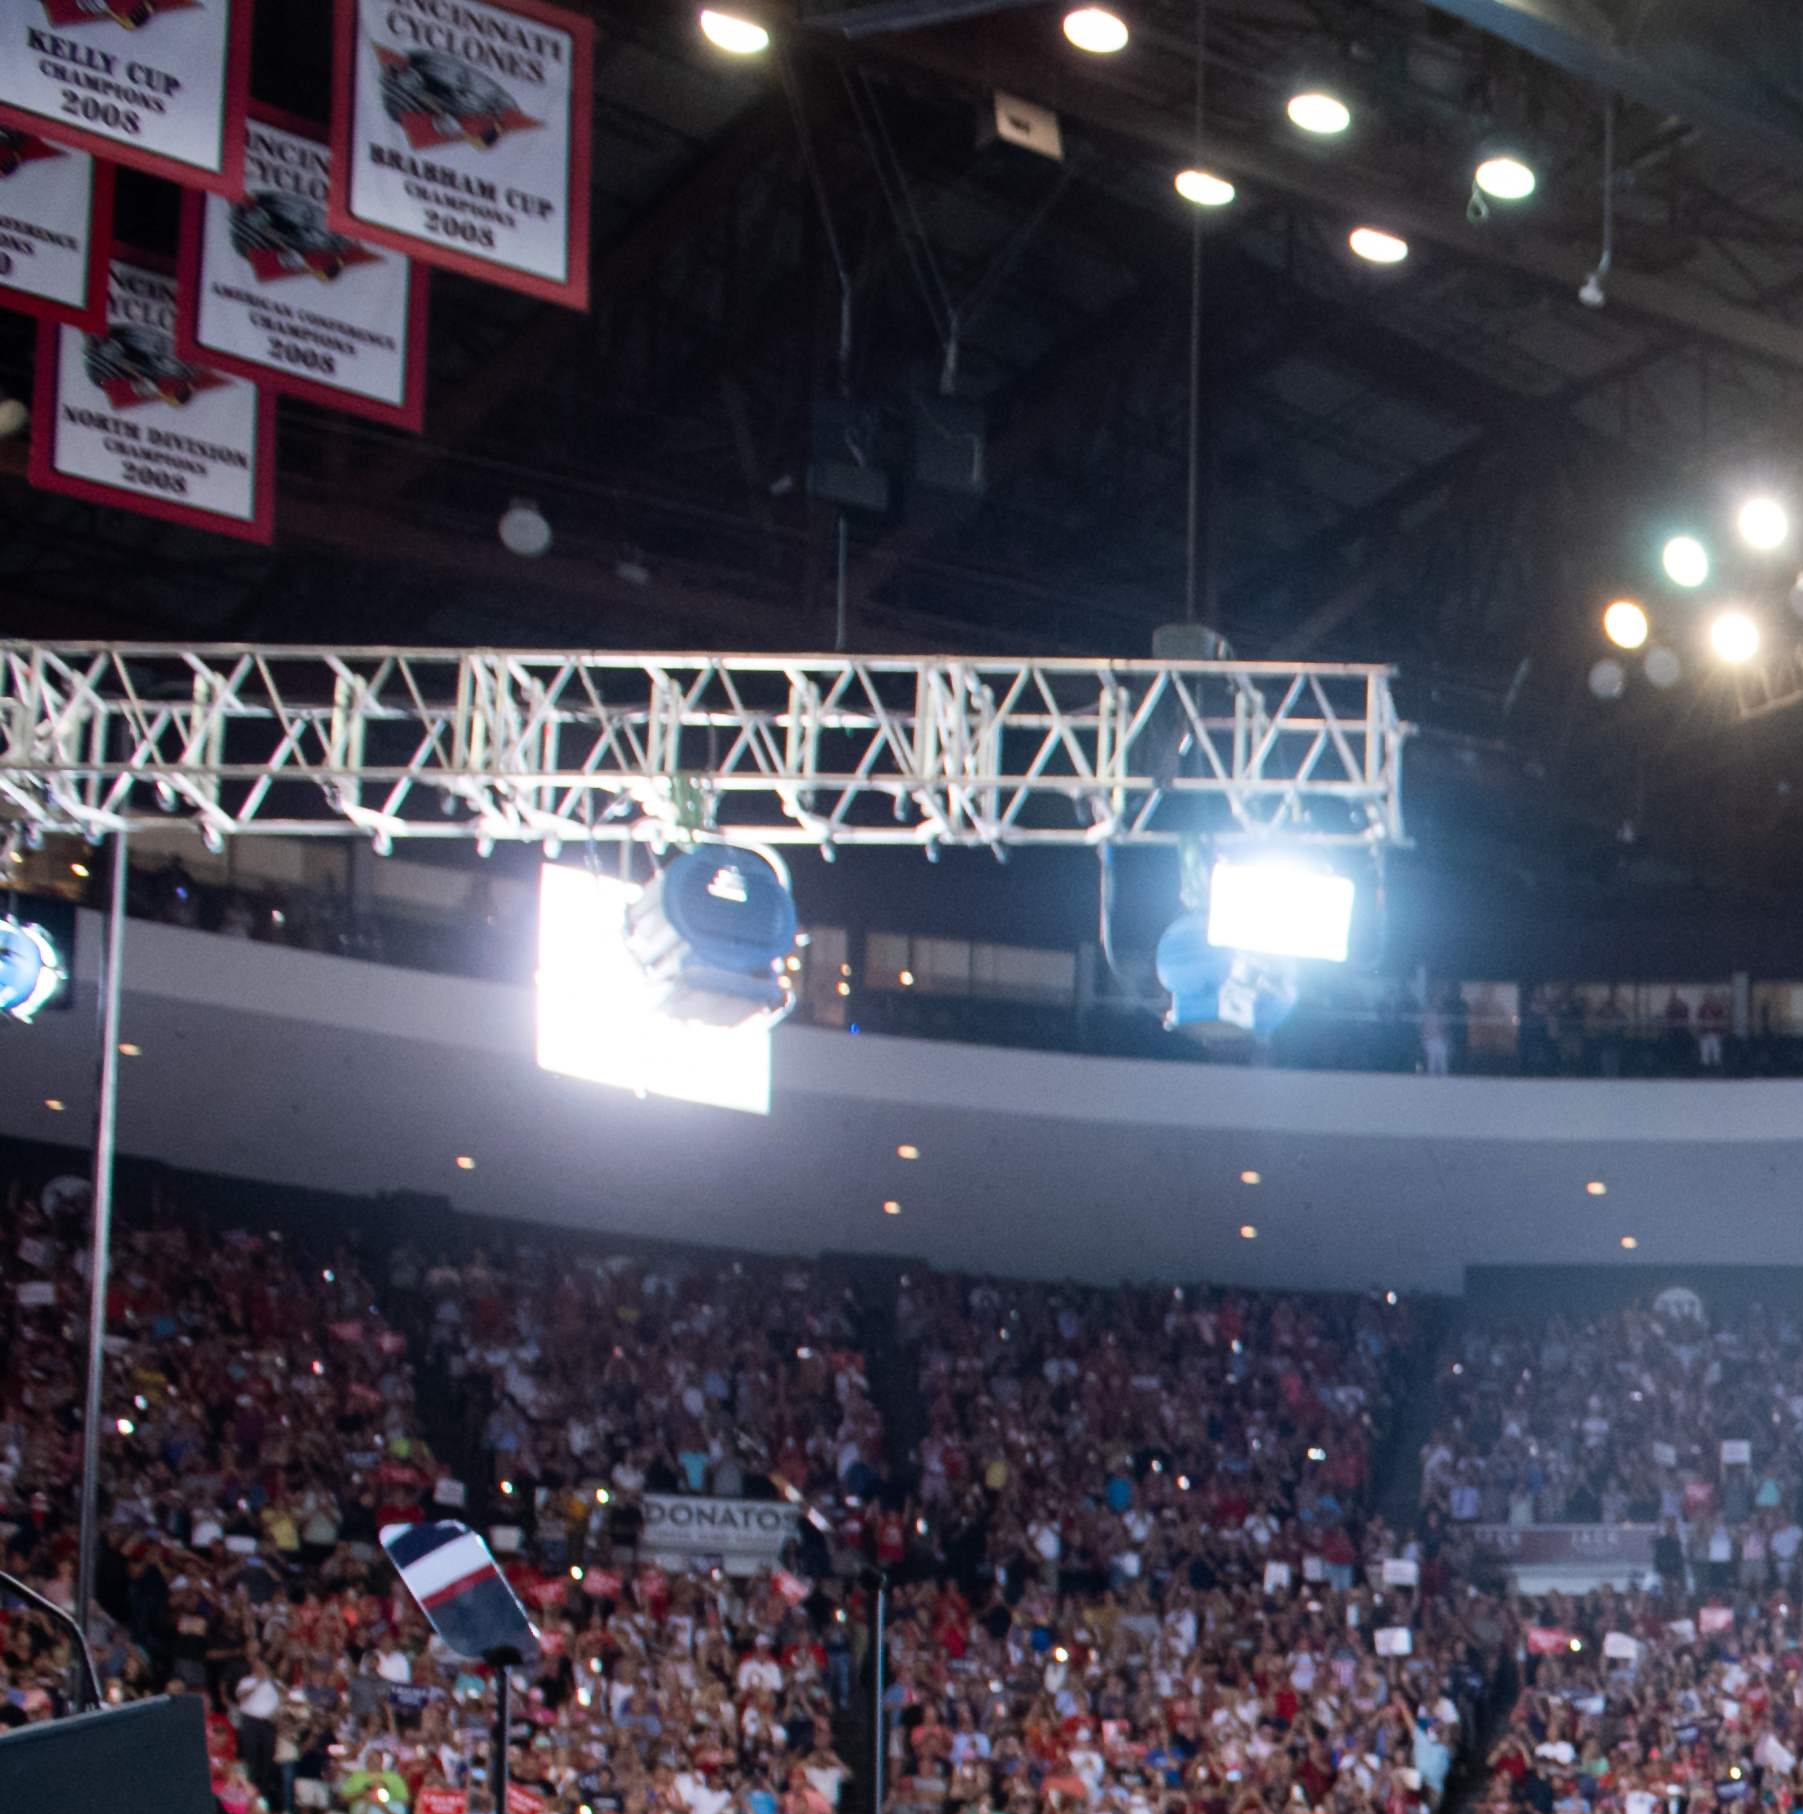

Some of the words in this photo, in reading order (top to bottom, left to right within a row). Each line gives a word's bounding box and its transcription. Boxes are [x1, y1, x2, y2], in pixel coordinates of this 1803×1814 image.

[27, 26, 118, 76] KELLY
[125, 62, 182, 96] CUP
[387, 10, 545, 83] CYCLONES
[38, 59, 166, 113] CHAMPIONS
[61, 89, 140, 134] 2008
[369, 142, 498, 202] BRABHAM
[505, 187, 554, 221] CUP
[404, 179, 516, 228] CHAMPIONS
[423, 207, 496, 248] 2008
[268, 336, 337, 375] 2008
[62, 404, 140, 440] NORTH
[147, 426, 248, 468] DIVISION
[122, 460, 187, 493] 2008
